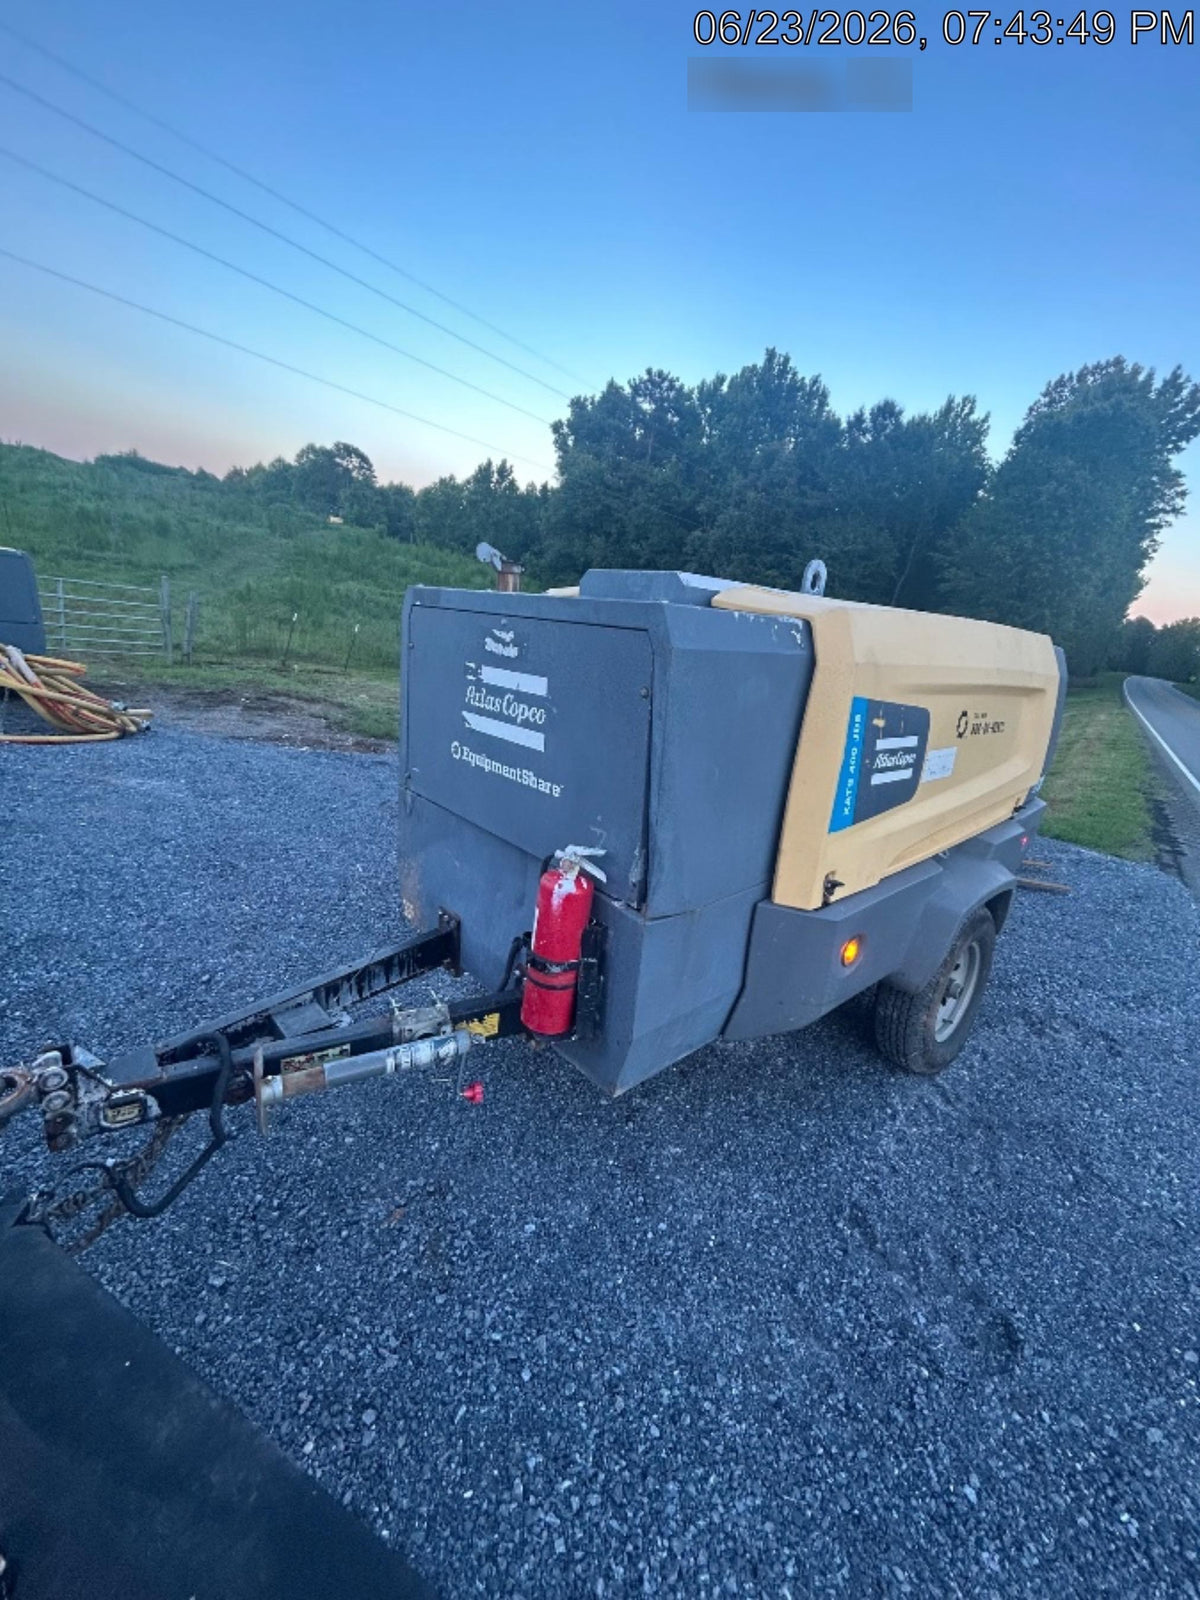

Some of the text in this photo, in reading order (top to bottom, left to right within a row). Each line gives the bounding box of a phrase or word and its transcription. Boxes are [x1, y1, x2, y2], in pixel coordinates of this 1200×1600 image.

[465, 685, 547, 725] Atlas Copco
[461, 745, 561, 797] EquipmentShare
